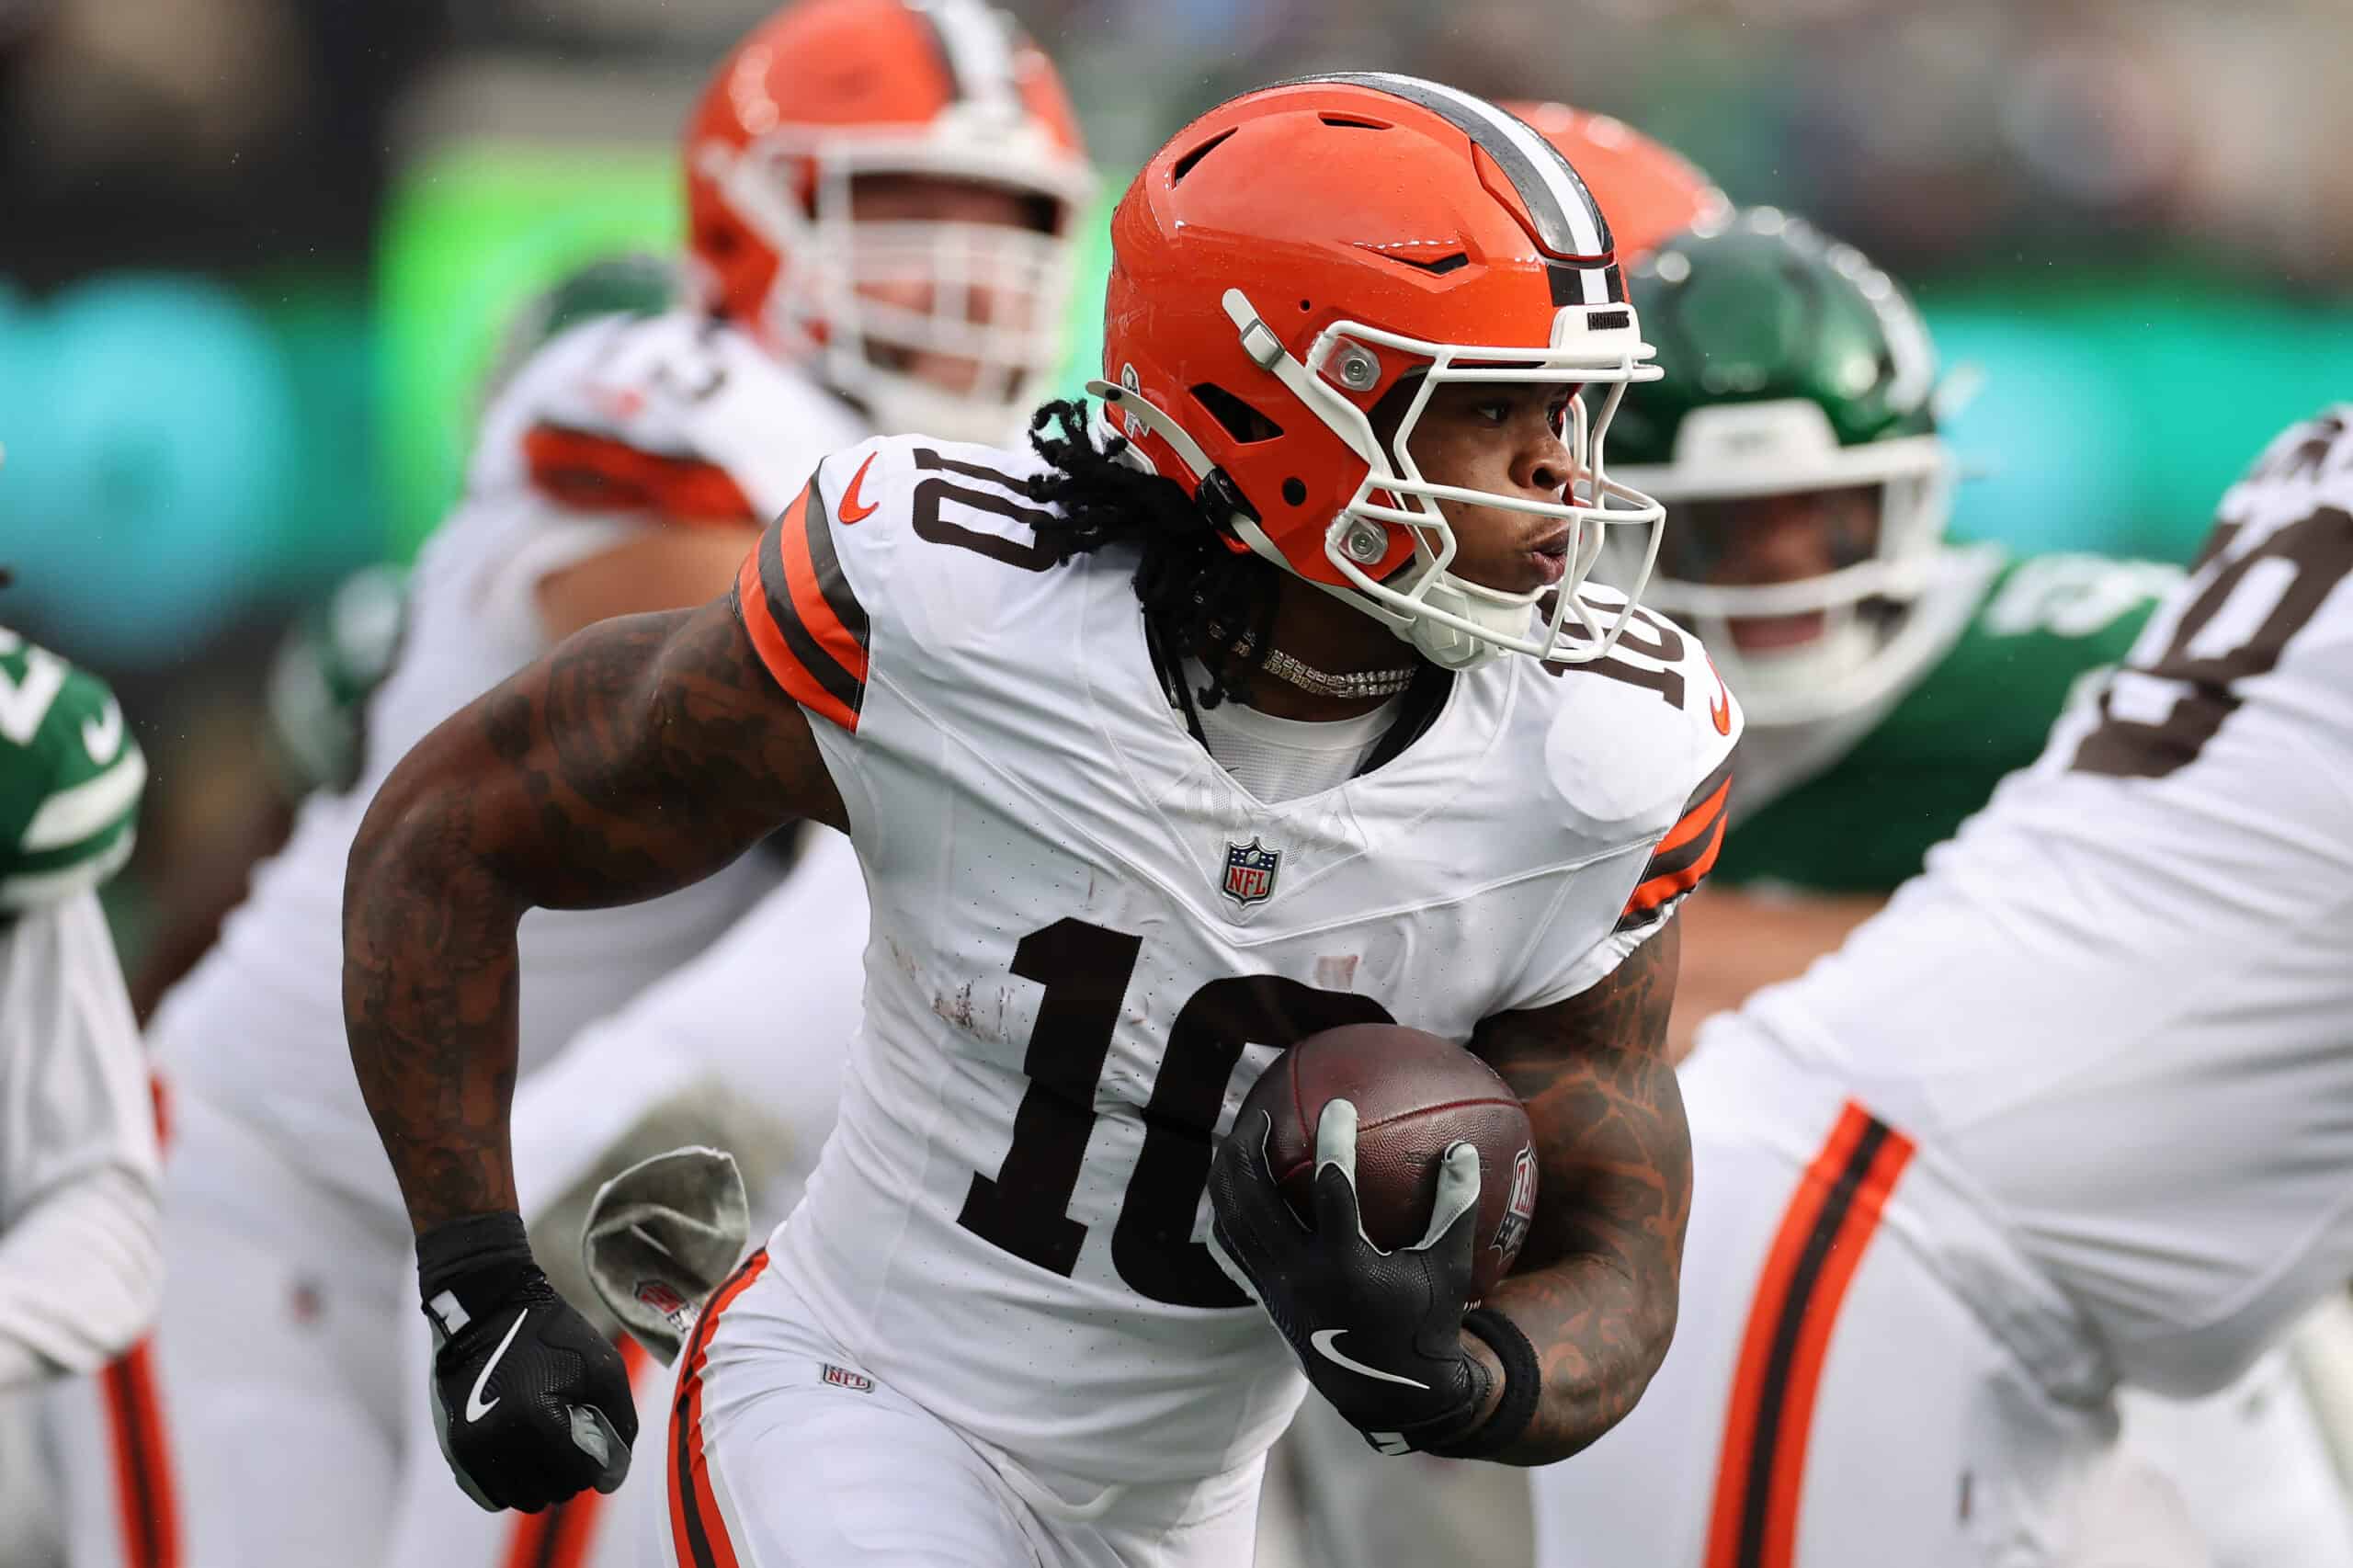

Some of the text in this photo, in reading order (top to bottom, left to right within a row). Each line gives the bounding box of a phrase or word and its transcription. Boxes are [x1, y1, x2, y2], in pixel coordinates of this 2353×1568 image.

[913, 448, 1059, 572] 10
[1536, 589, 1685, 710] 10
[1228, 867, 1267, 897] NFL
[829, 1368, 866, 1386] NFL
